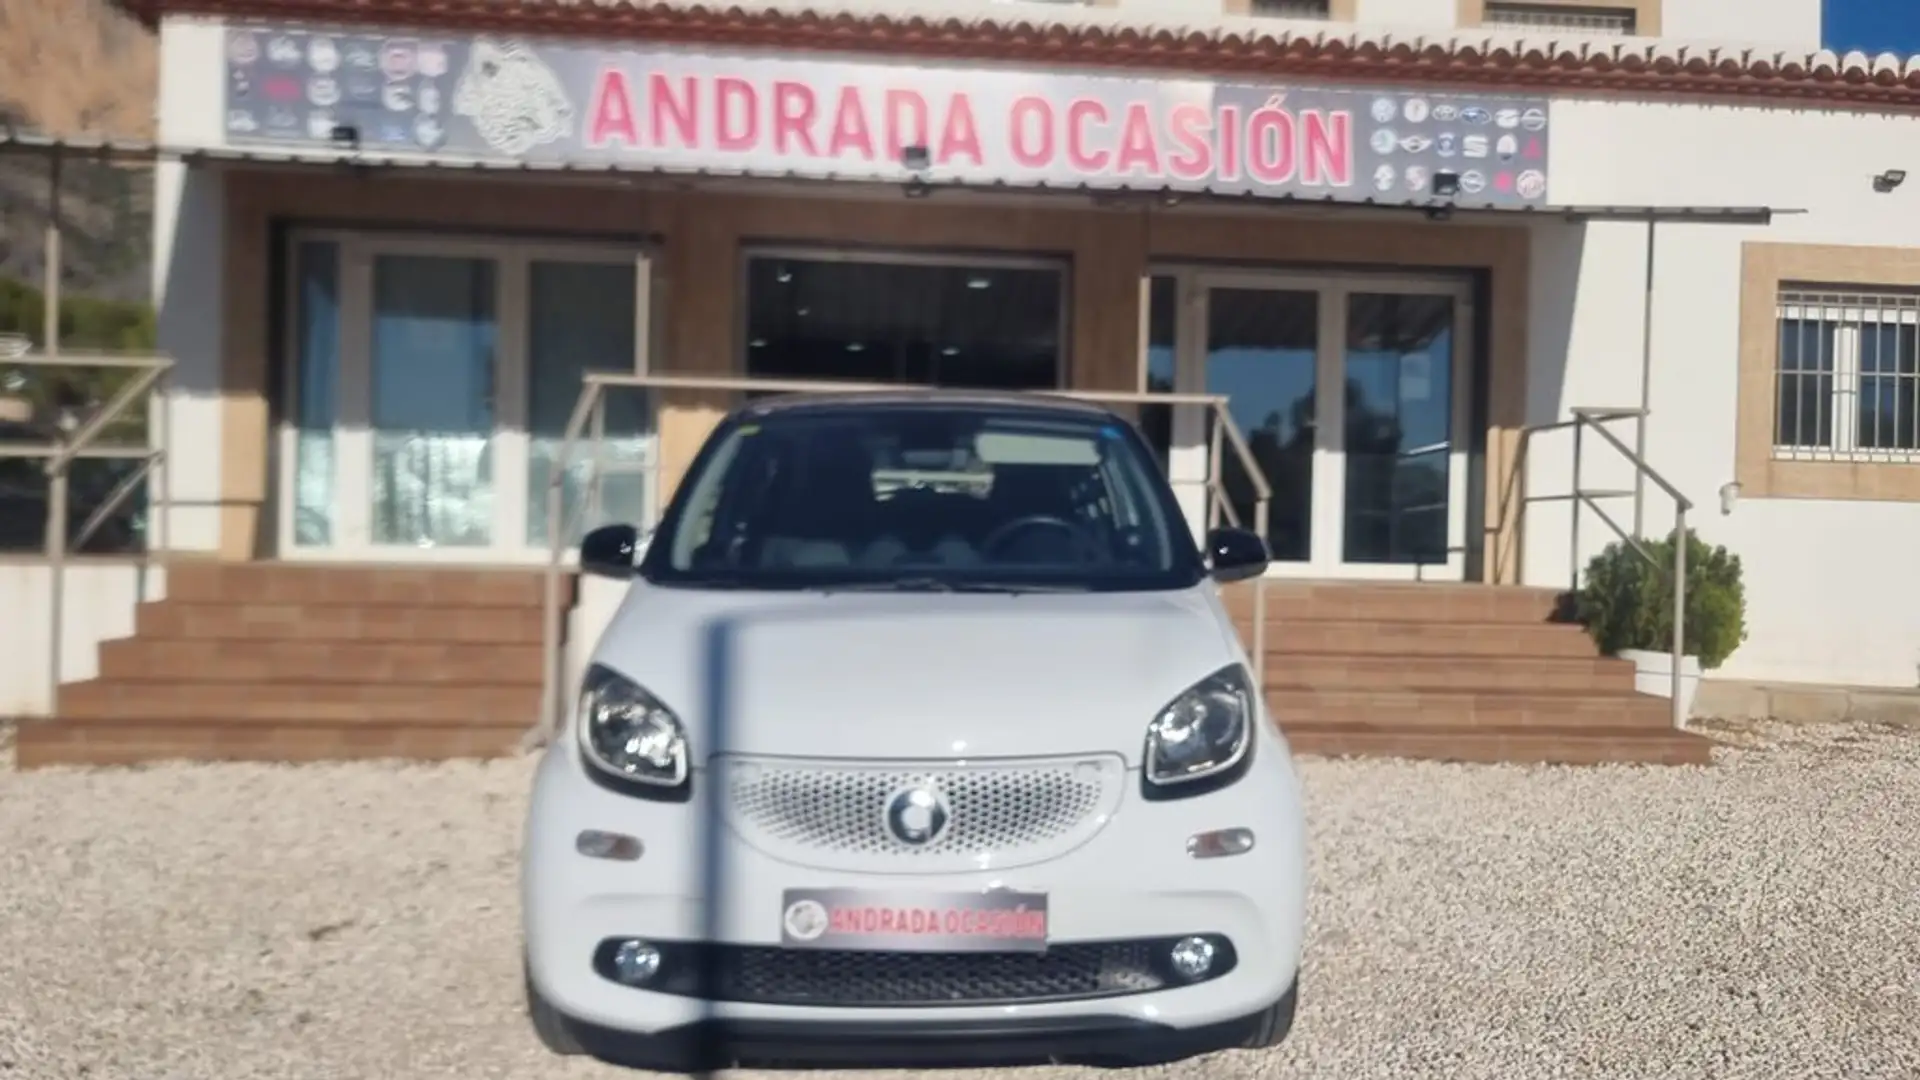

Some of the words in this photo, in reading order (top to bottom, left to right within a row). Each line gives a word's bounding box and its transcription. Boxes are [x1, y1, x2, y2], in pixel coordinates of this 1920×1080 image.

[586, 68, 985, 167] ANDRADA
[1007, 94, 1352, 187] OCASIÓN
[831, 906, 940, 935] ANDRADA
